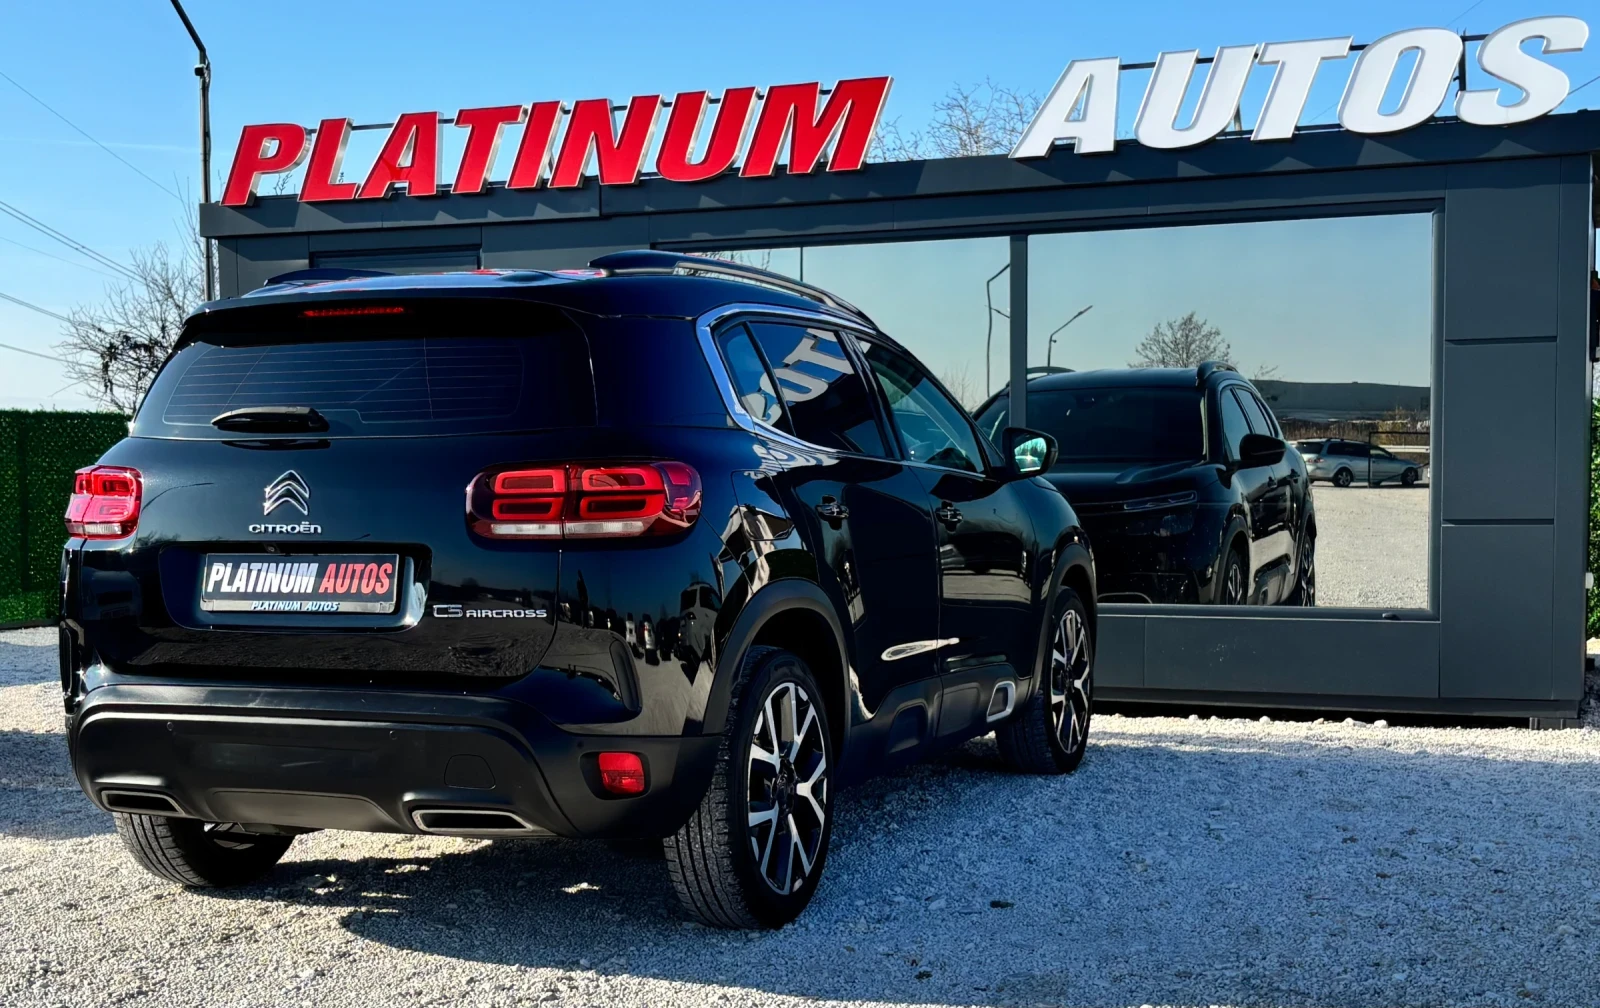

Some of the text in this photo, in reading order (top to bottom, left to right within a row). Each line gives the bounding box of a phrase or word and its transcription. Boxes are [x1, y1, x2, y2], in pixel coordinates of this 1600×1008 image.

[219, 14, 1590, 207] PLATINUM AUTOS
[206, 562, 393, 594] PLATINUM AUTOS
[251, 601, 340, 611] PLATINUM AUTOS
[465, 609, 548, 618] AIRCROSS
